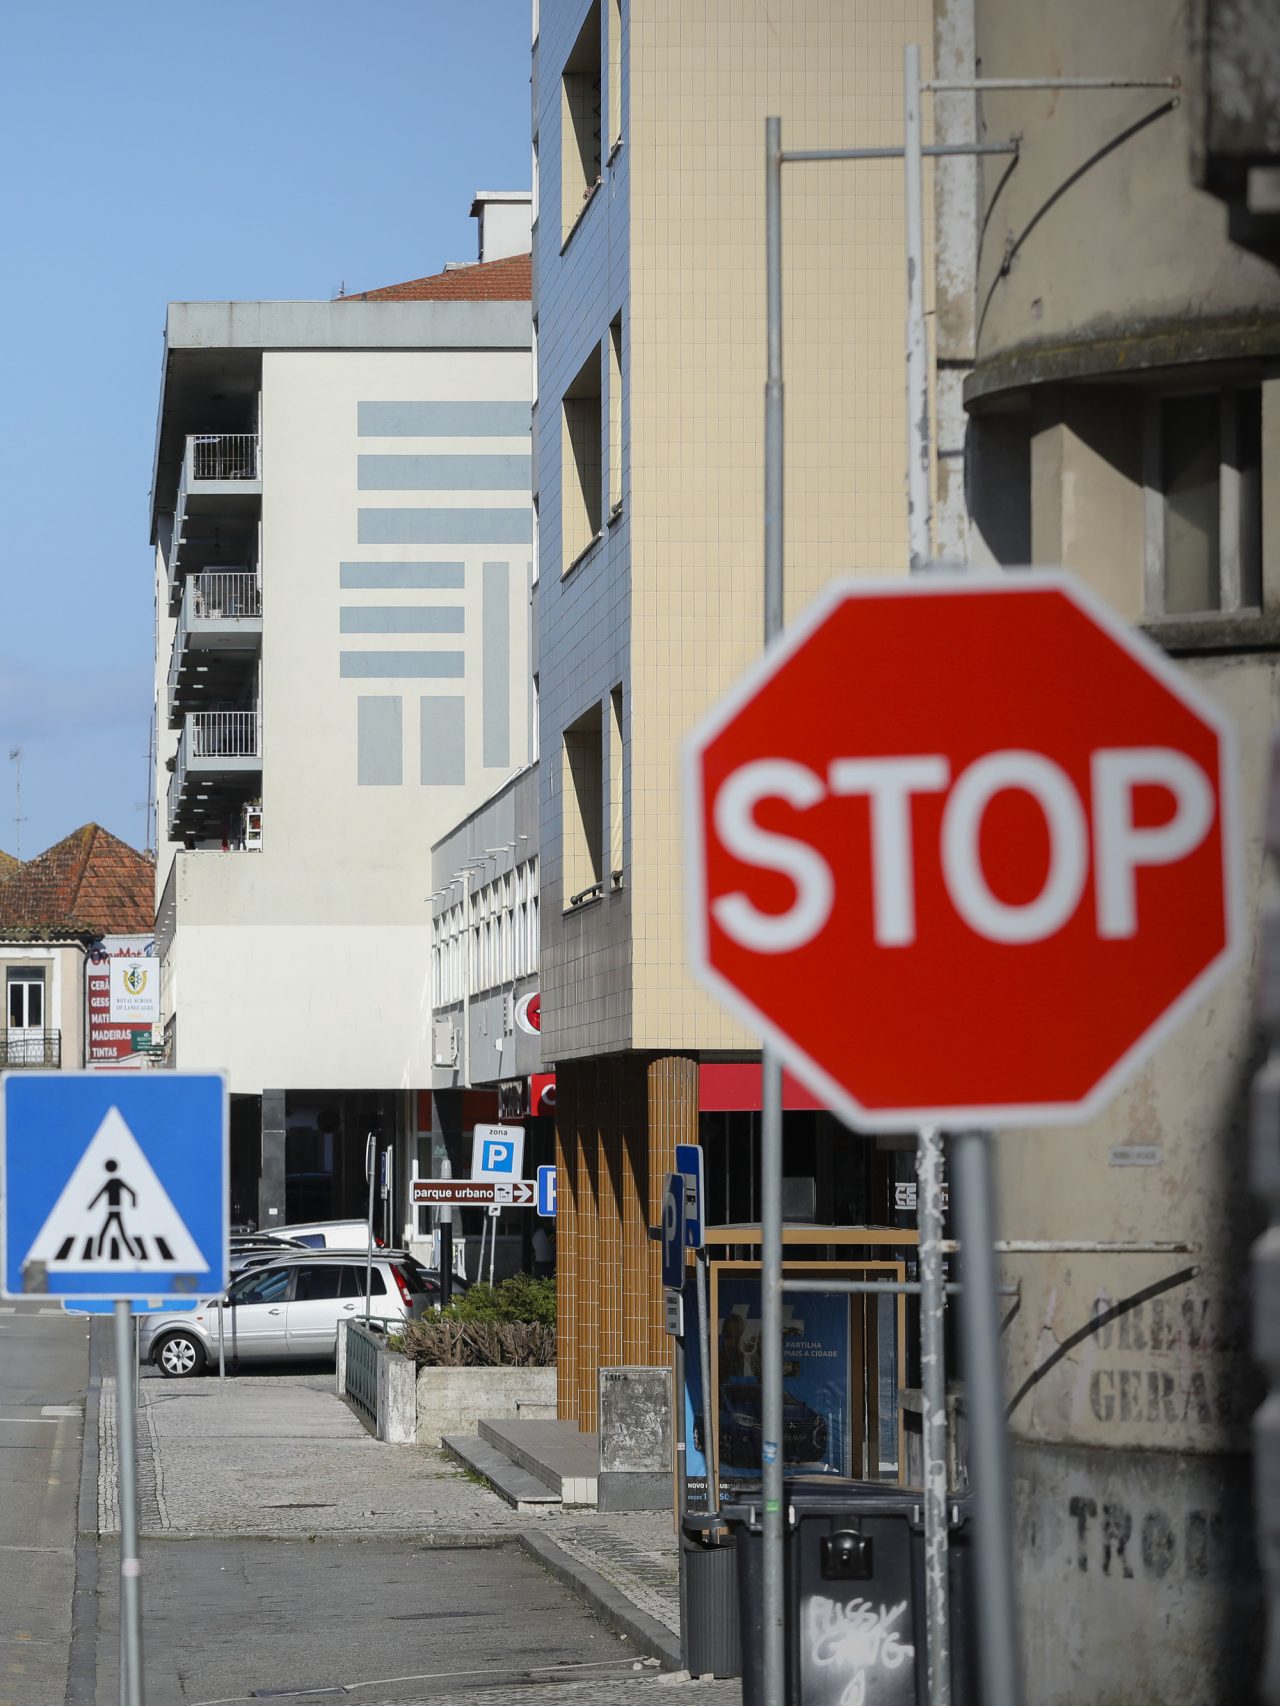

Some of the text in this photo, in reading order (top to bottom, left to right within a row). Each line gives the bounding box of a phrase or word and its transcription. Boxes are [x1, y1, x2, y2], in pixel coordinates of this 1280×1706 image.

[711, 746, 1215, 954] STOP
[90, 978, 110, 991] CERÂ
[91, 997, 110, 1008] GESS
[91, 1013, 110, 1024] MATE
[92, 1029, 132, 1041] MADEIRAS
[92, 1047, 118, 1057] TINTAS
[487, 1144, 508, 1169] P
[414, 1187, 494, 1200] parque urbano
[1091, 1296, 1228, 1352] GREV
[785, 1341, 822, 1349] PARTILHA
[1090, 1368, 1228, 1423] GERA
